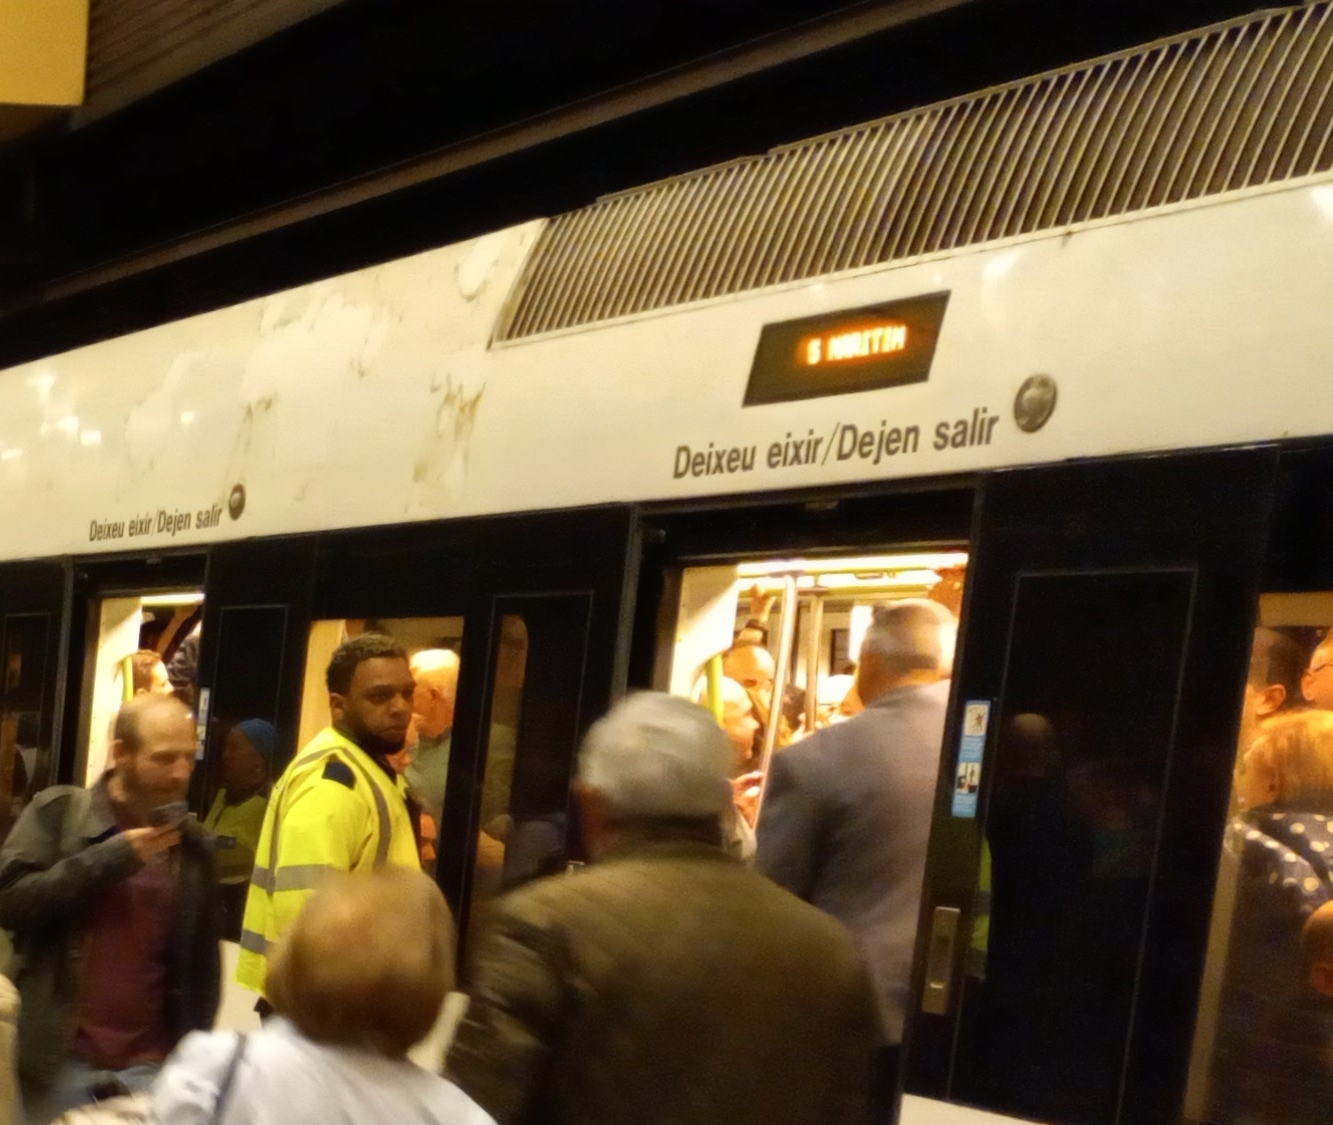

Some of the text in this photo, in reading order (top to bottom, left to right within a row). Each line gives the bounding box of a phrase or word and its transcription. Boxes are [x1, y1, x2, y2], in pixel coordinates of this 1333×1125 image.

[673, 443, 756, 480] Deixeu
[933, 406, 999, 450] salir
[89, 518, 124, 542] Deixeu
[196, 502, 223, 530] salir
